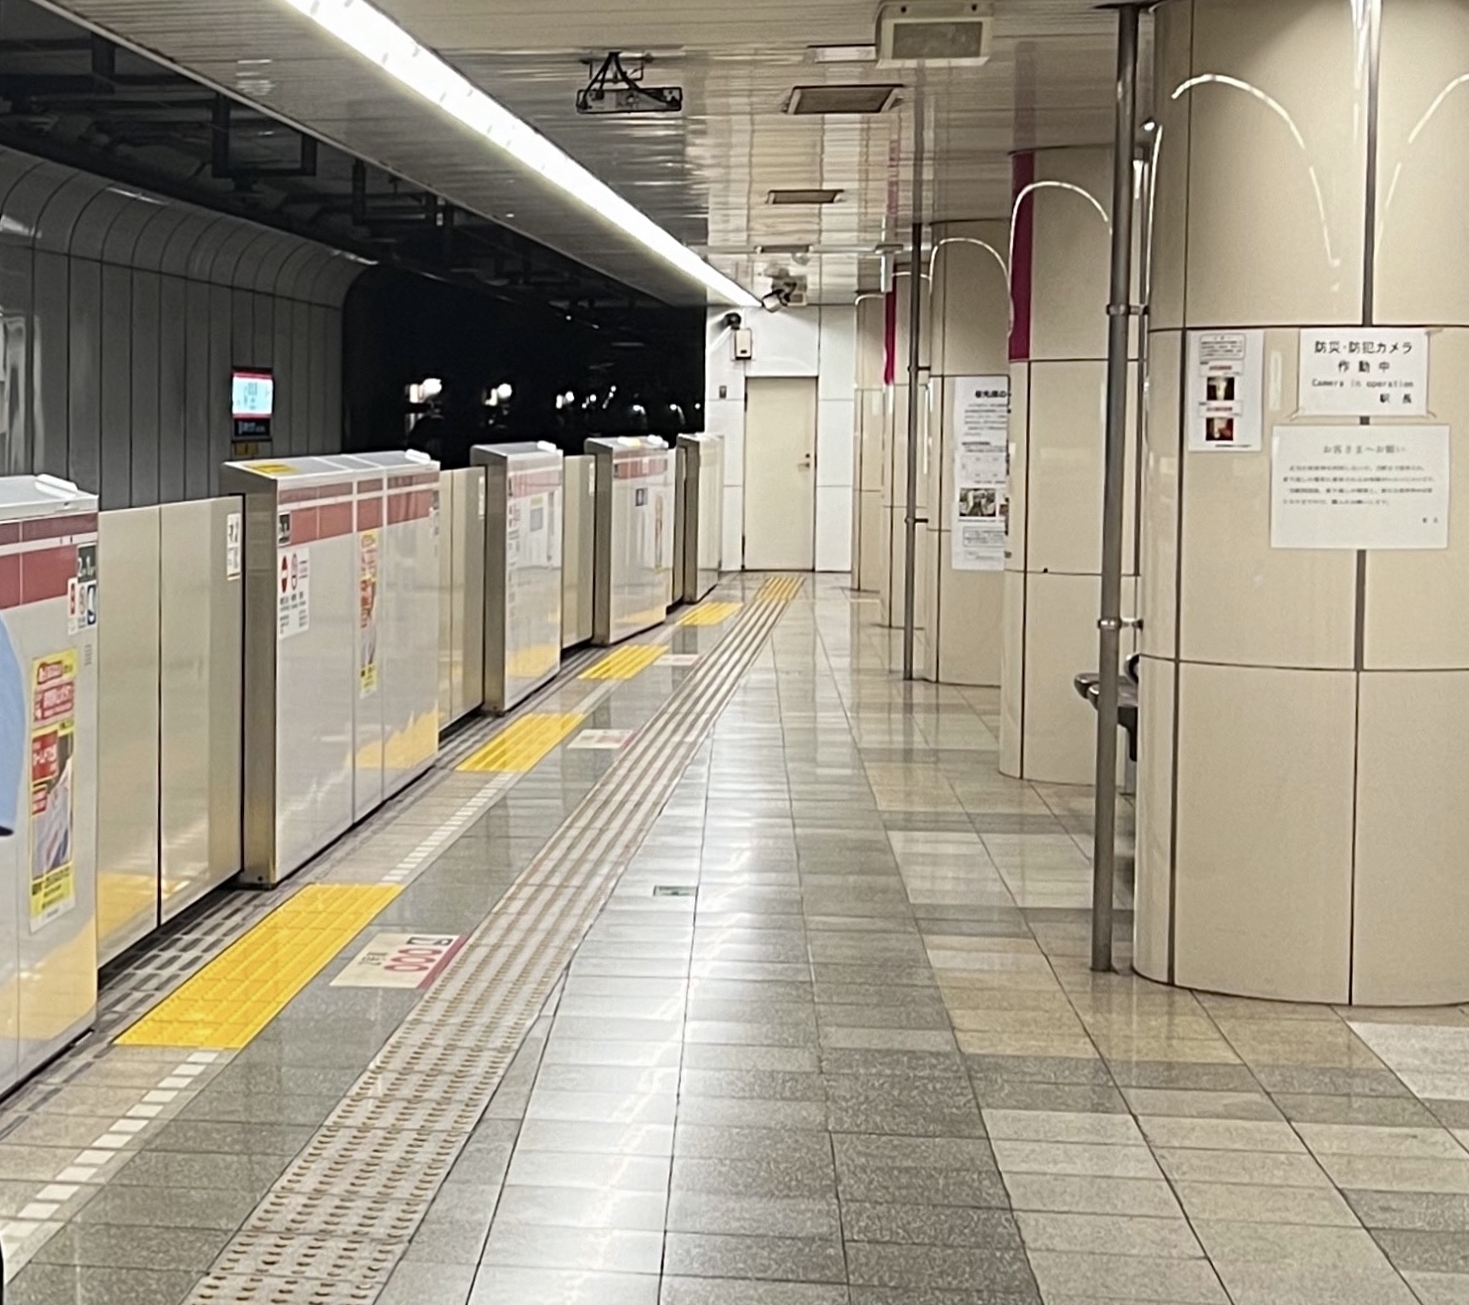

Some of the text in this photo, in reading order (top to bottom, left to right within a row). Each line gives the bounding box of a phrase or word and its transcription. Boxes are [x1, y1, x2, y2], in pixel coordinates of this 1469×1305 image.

[1312, 379, 1414, 388] Camera in operation
